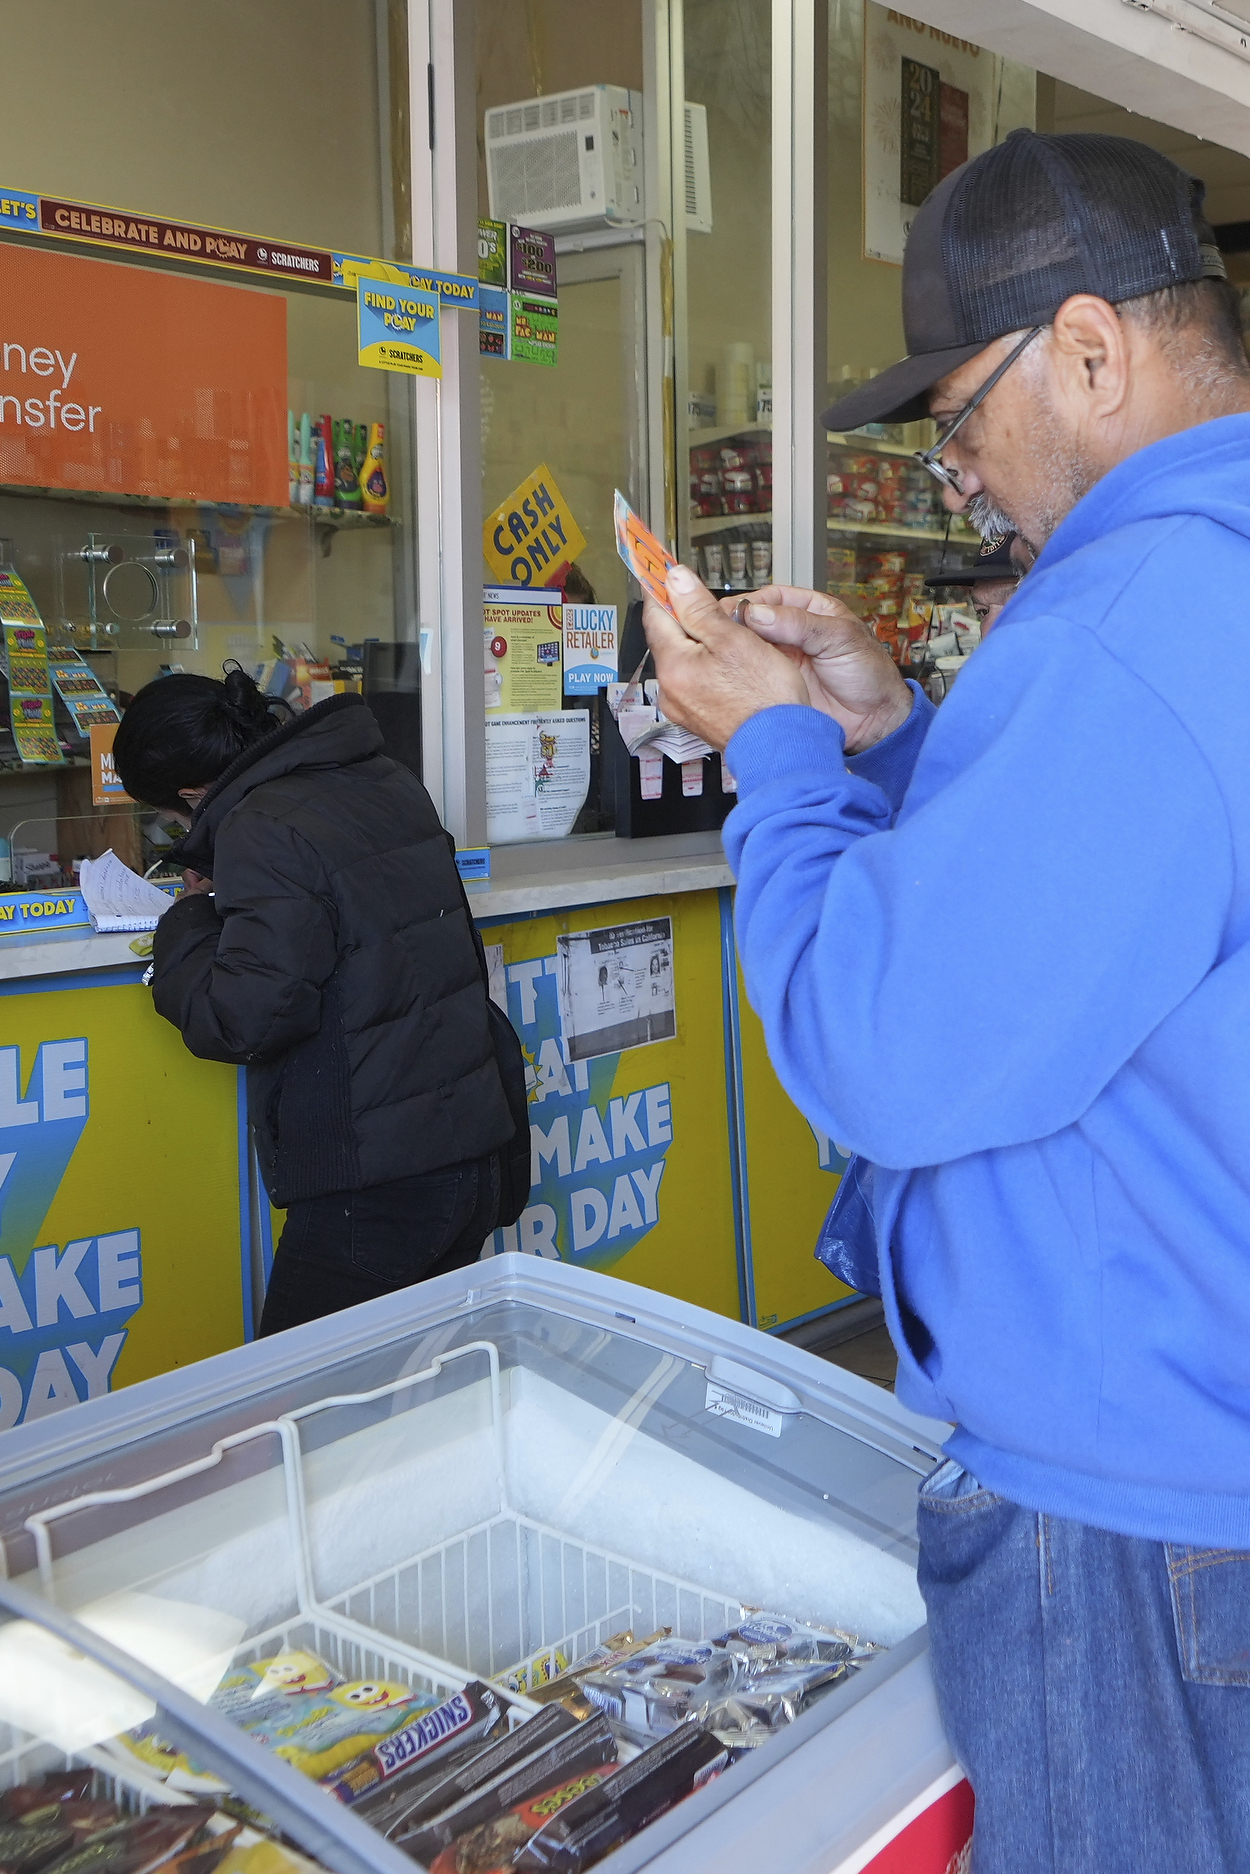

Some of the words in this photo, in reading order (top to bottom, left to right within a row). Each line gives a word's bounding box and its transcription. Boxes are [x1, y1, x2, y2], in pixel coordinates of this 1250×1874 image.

[0, 198, 37, 219] ET'S
[55, 208, 159, 244] CELEBRATE
[163, 229, 202, 251] AND
[271, 251, 320, 272] SCRATCHERS
[436, 280, 475, 299] TODAY
[364, 291, 396, 310] FIND
[399, 298, 435, 319] YOUR
[3, 342, 77, 388] ney
[389, 349, 423, 363] SCRATCHERS
[0, 388, 102, 433] nsfer
[493, 482, 556, 556] CASH
[510, 514, 568, 587] ONLY
[503, 616, 533, 624] ARRIVED!
[512, 610, 541, 618] UPDATES
[574, 608, 614, 631] LUCKY
[566, 631, 615, 649] RETAILER
[568, 673, 591, 683] PLAY
[594, 673, 614, 683] NOW
[20, 898, 76, 918] TODAY
[530, 1083, 672, 1188] MAKE
[571, 1159, 665, 1252] DAY
[378, 1694, 468, 1769] SNICKERS
